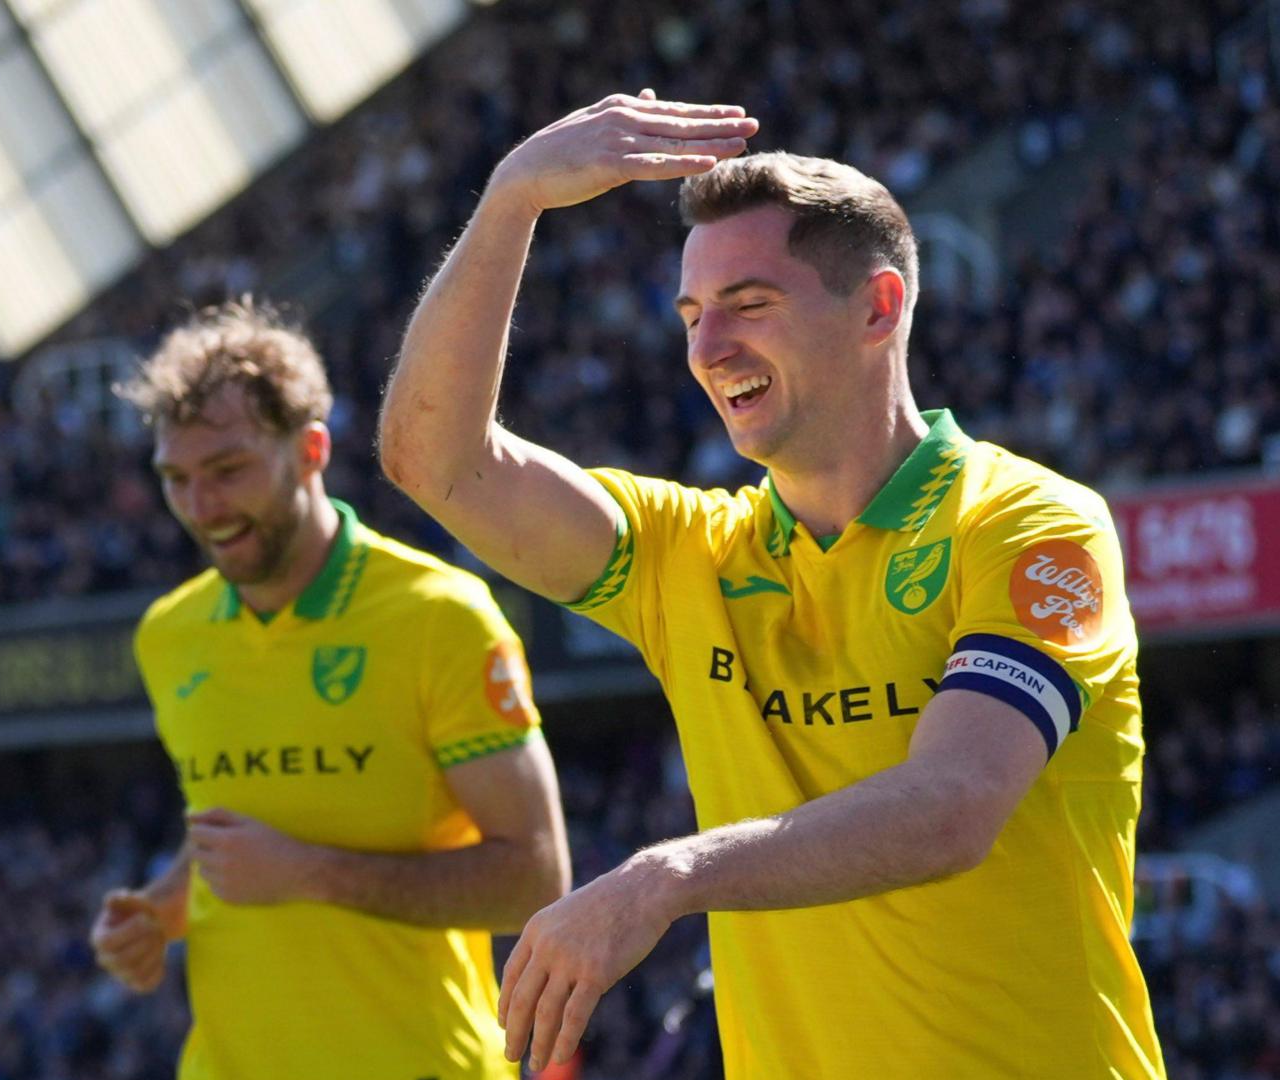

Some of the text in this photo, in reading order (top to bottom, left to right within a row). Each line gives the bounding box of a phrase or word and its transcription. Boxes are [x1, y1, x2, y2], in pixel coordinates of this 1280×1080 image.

[1024, 554, 1102, 613] Willy's
[1030, 595, 1085, 639] Pies
[709, 646, 941, 726] BAKEL
[972, 656, 1046, 695] CAPTAIN
[181, 744, 375, 784] LAKELY
